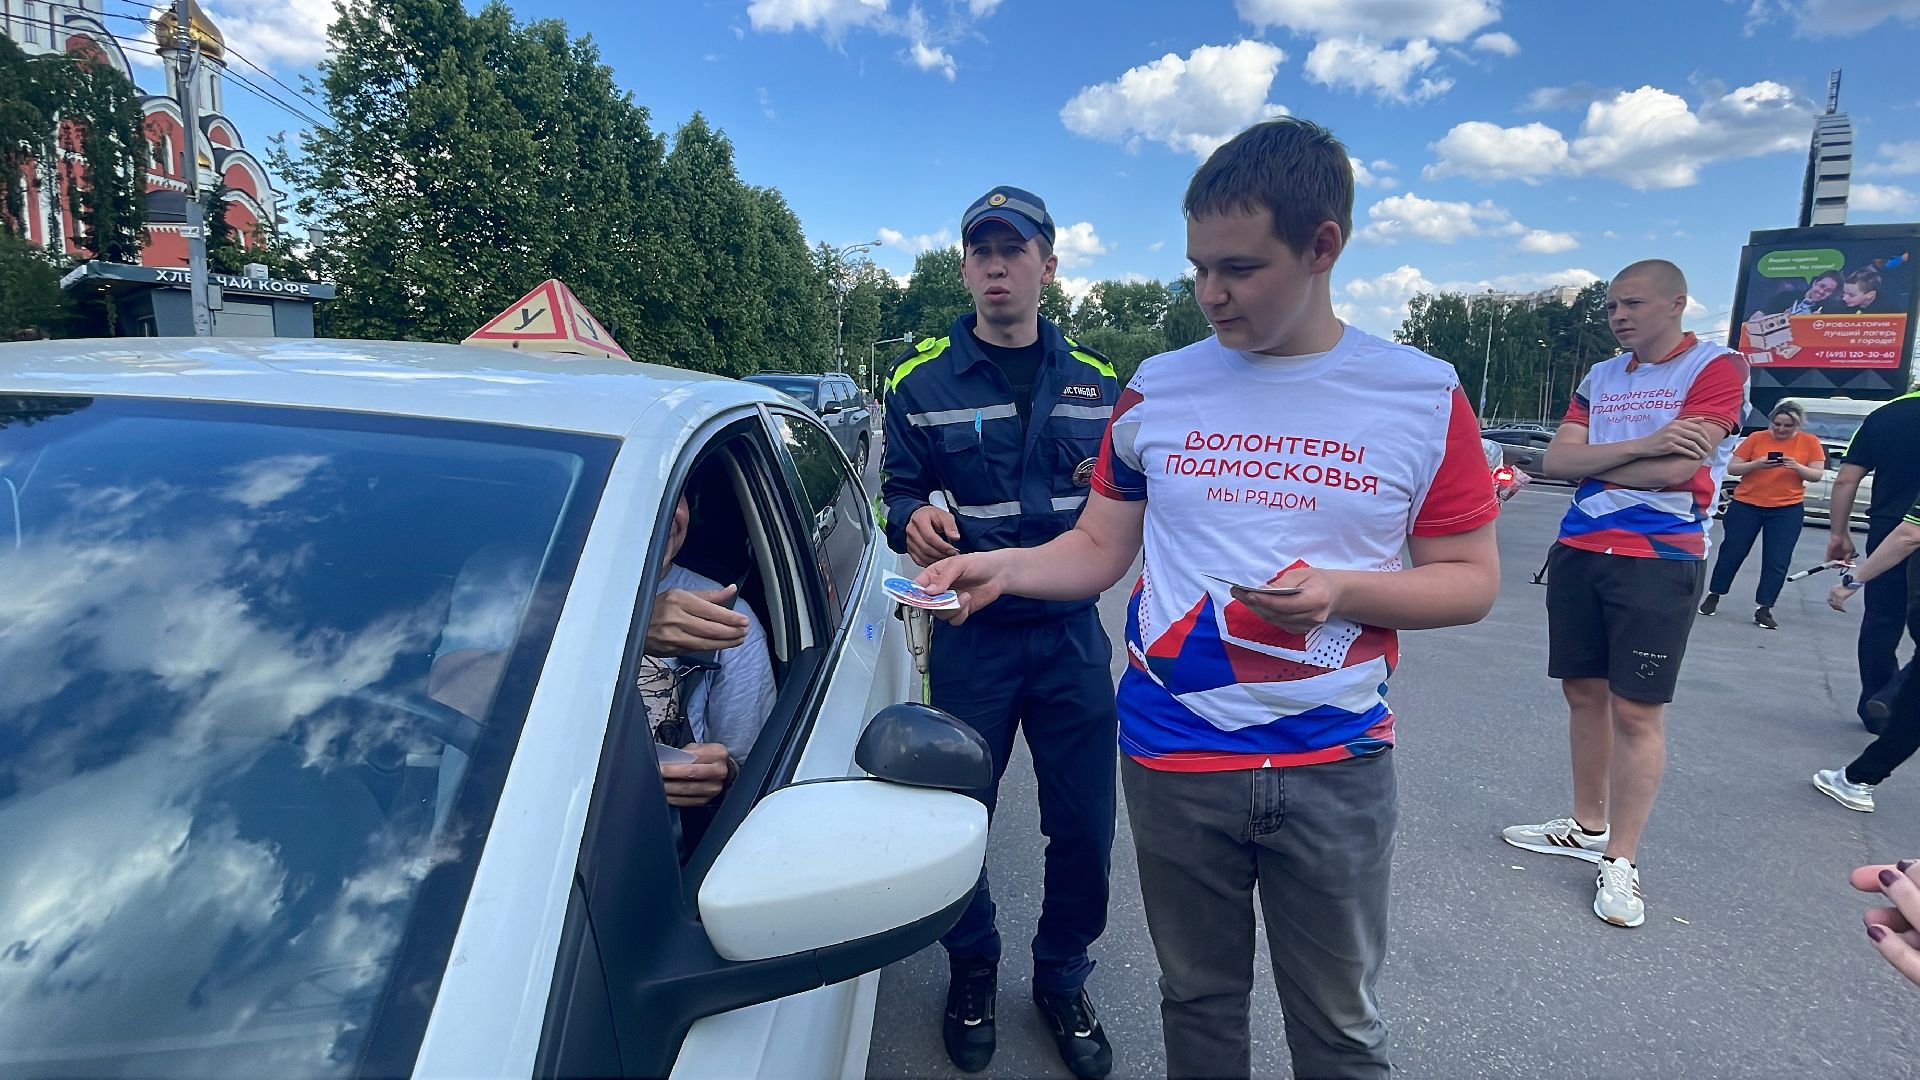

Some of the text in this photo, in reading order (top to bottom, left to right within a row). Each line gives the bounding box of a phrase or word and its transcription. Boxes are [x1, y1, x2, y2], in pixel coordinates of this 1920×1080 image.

[156, 270, 310, 295] ХЛЕ ЧАЙ КОФЕ
[514, 308, 546, 331] У
[1823, 329, 1860, 338] лучший
[1825, 350, 1847, 358] (495)
[1184, 430, 1366, 464] ВОЛОНТЕРЫ
[1165, 454, 1379, 495] ПОДМОСКОВЬЯ
[1207, 487, 1317, 512] МЫ РЯДОМ
